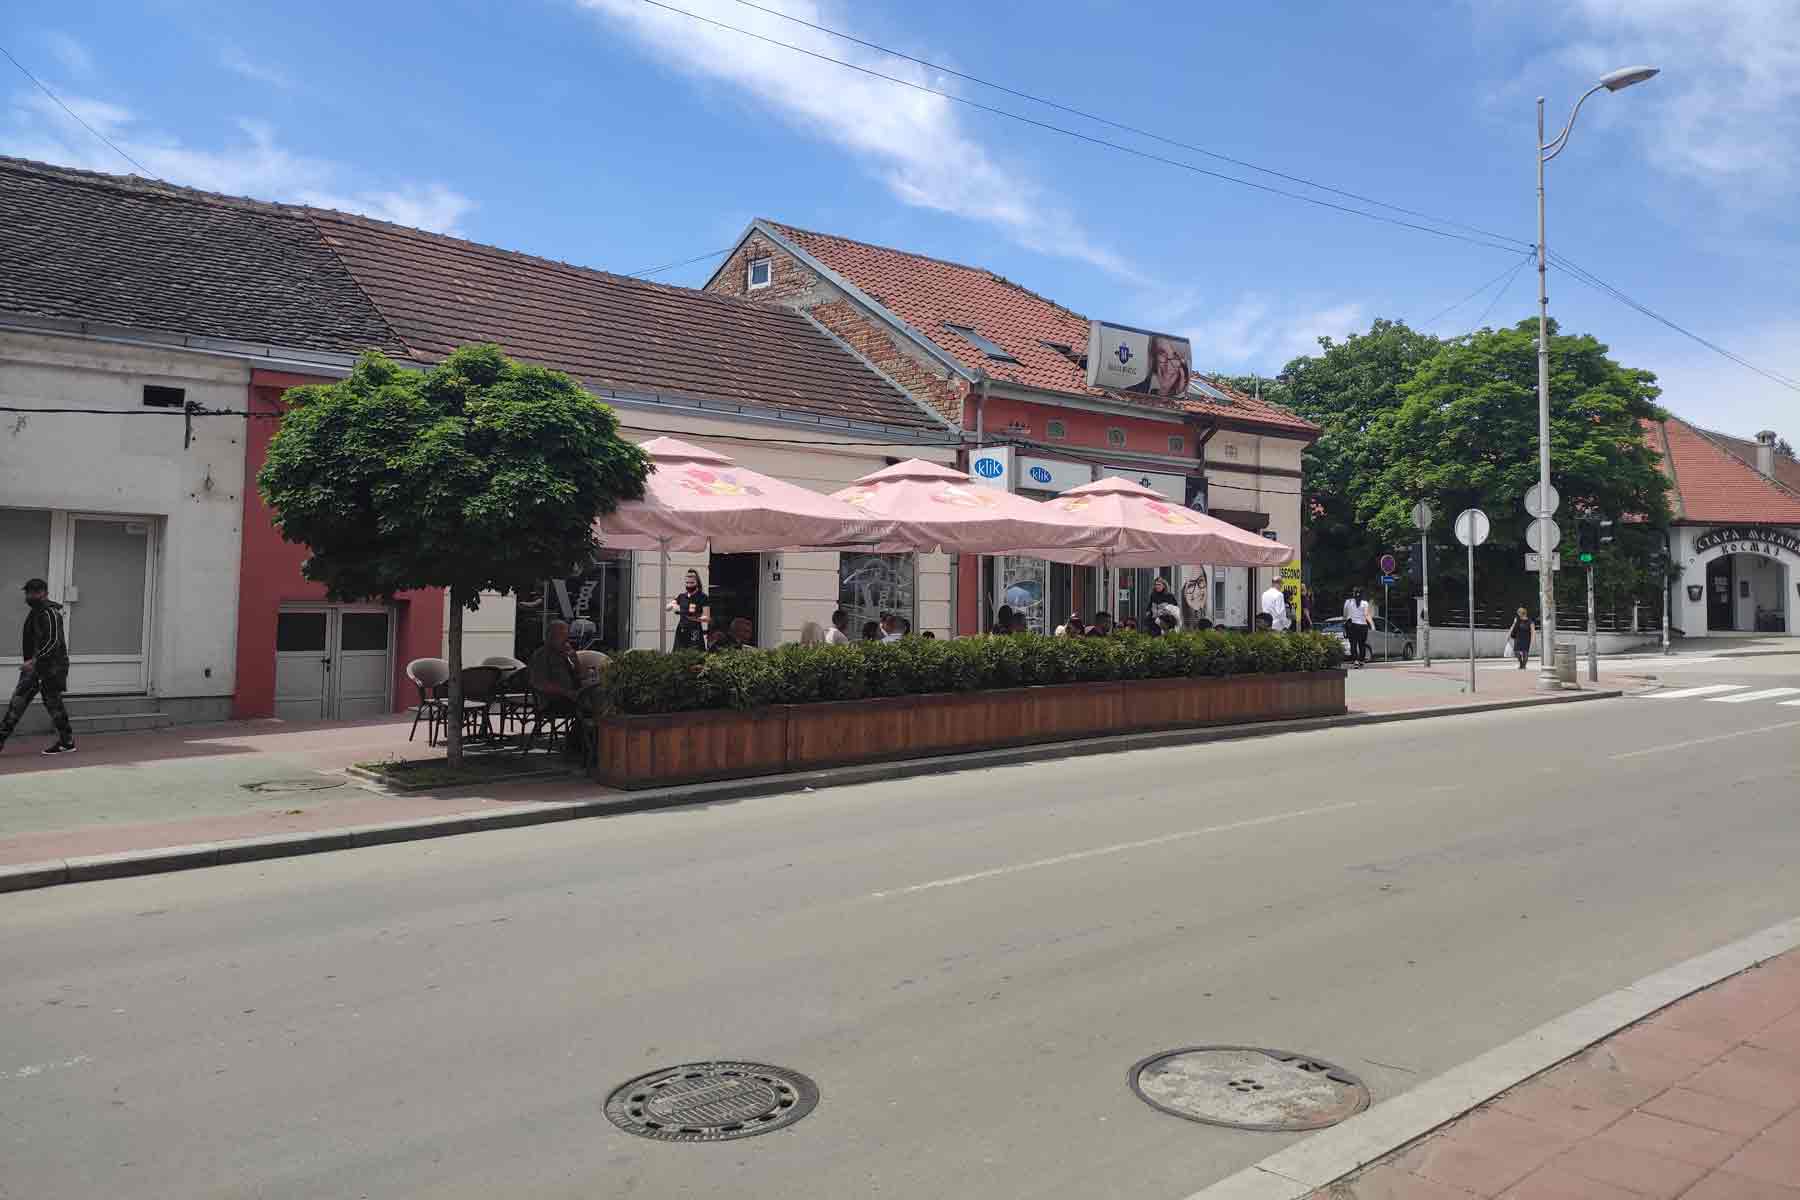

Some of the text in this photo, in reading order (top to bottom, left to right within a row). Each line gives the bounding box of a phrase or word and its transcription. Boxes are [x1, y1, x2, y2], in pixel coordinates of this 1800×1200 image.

[978, 459, 1000, 474] klik
[1032, 468, 1049, 481] klik
[1280, 567, 1300, 579] SECOND
